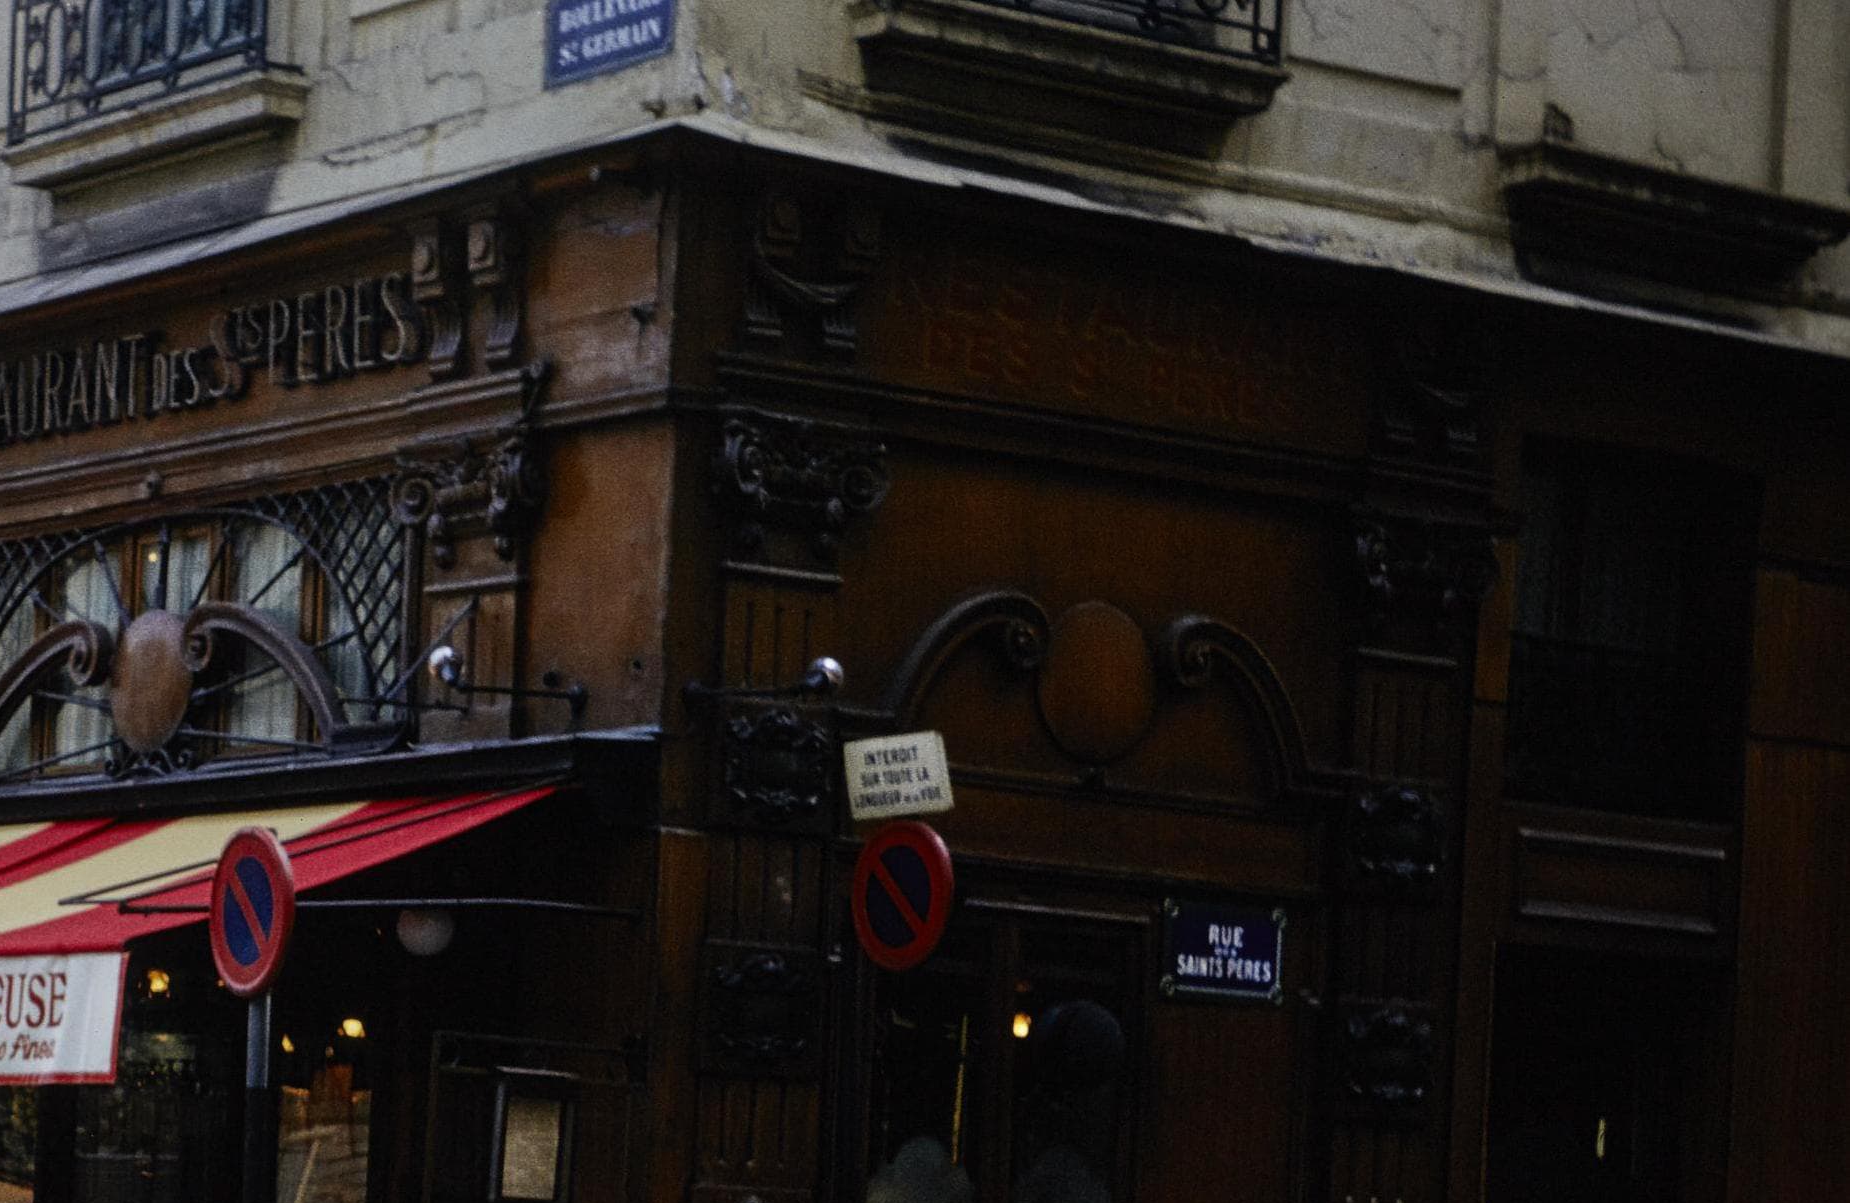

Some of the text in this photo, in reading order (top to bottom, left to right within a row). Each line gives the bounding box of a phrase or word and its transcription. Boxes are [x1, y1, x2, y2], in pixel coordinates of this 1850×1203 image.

[151, 347, 200, 412] DES
[268, 271, 408, 386] PERES
[863, 745, 919, 766] INTERDIT
[860, 767, 930, 788] SUR TOUTE LA
[1208, 923, 1245, 948] RUE
[1176, 953, 1223, 979] SAINTS
